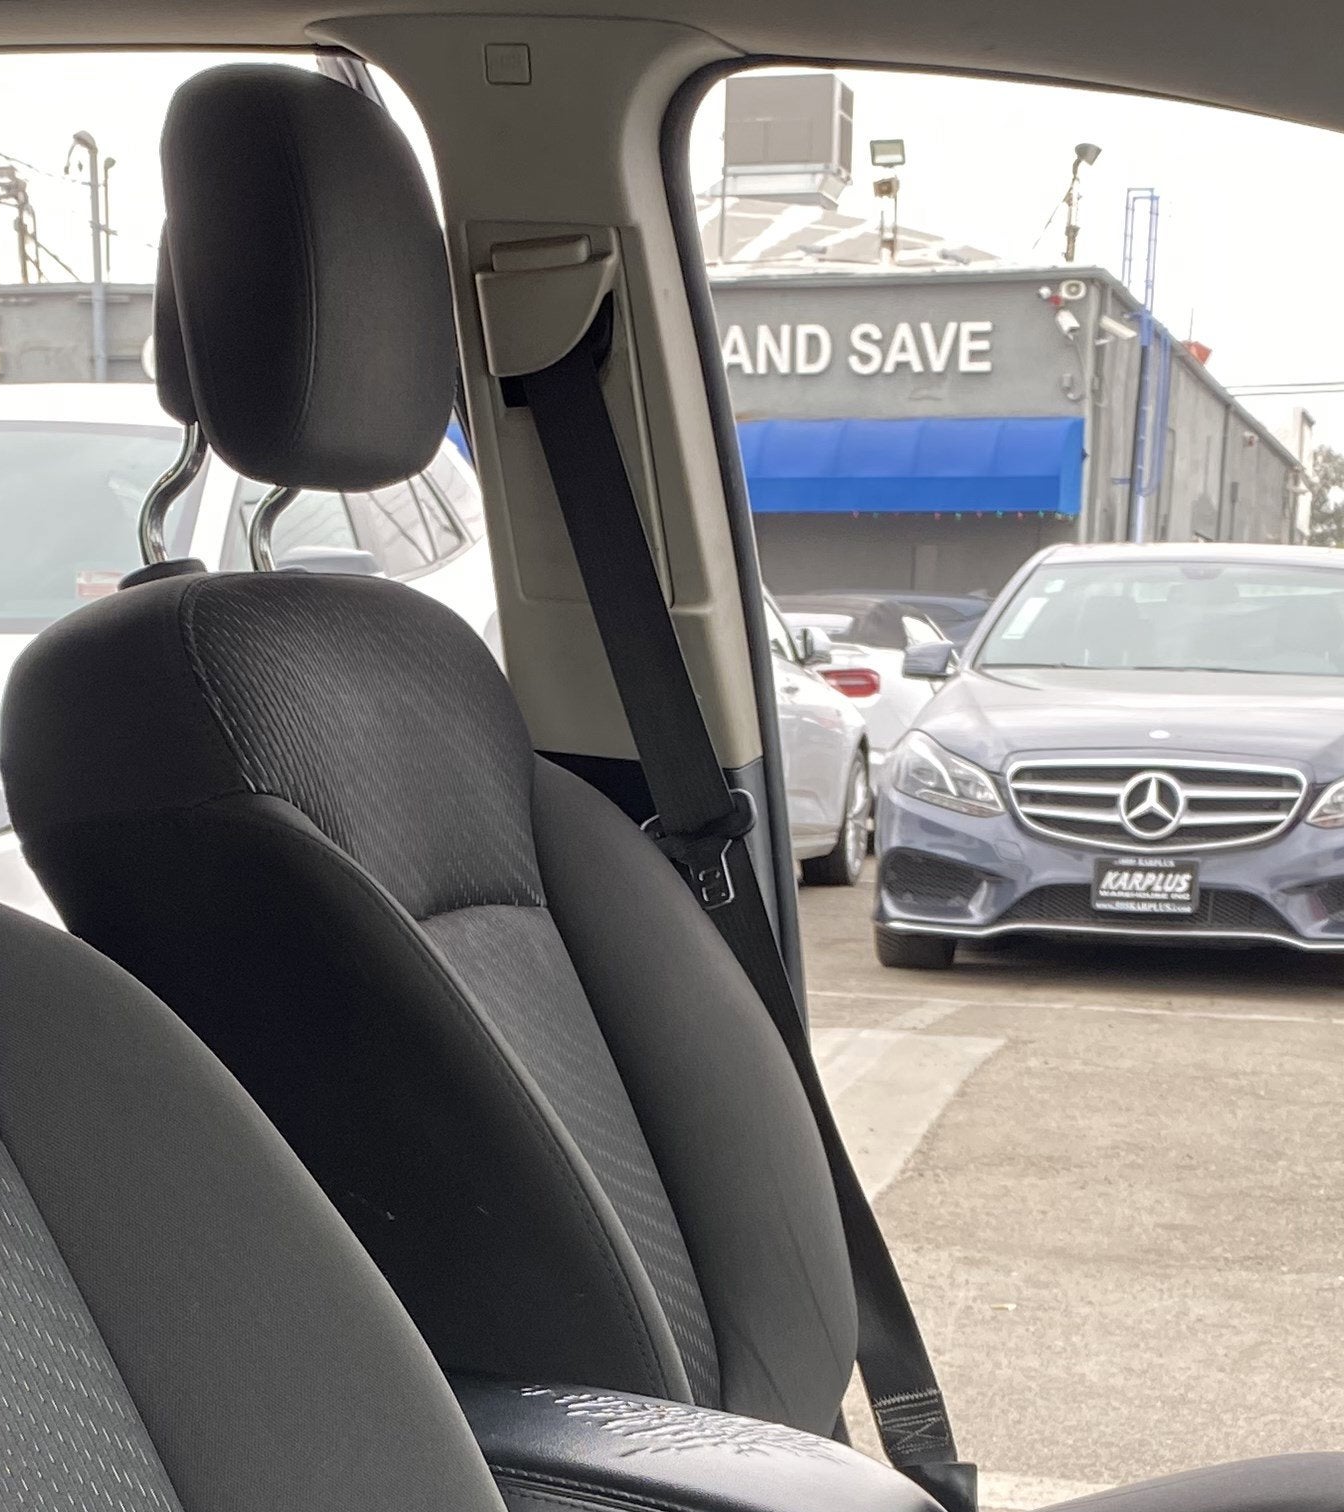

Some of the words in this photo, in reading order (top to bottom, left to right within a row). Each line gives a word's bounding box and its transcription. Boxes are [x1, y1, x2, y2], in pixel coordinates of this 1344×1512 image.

[722, 323, 832, 375] AND
[848, 321, 995, 375] SAVE
[1101, 871, 1192, 892] KARPLUS
